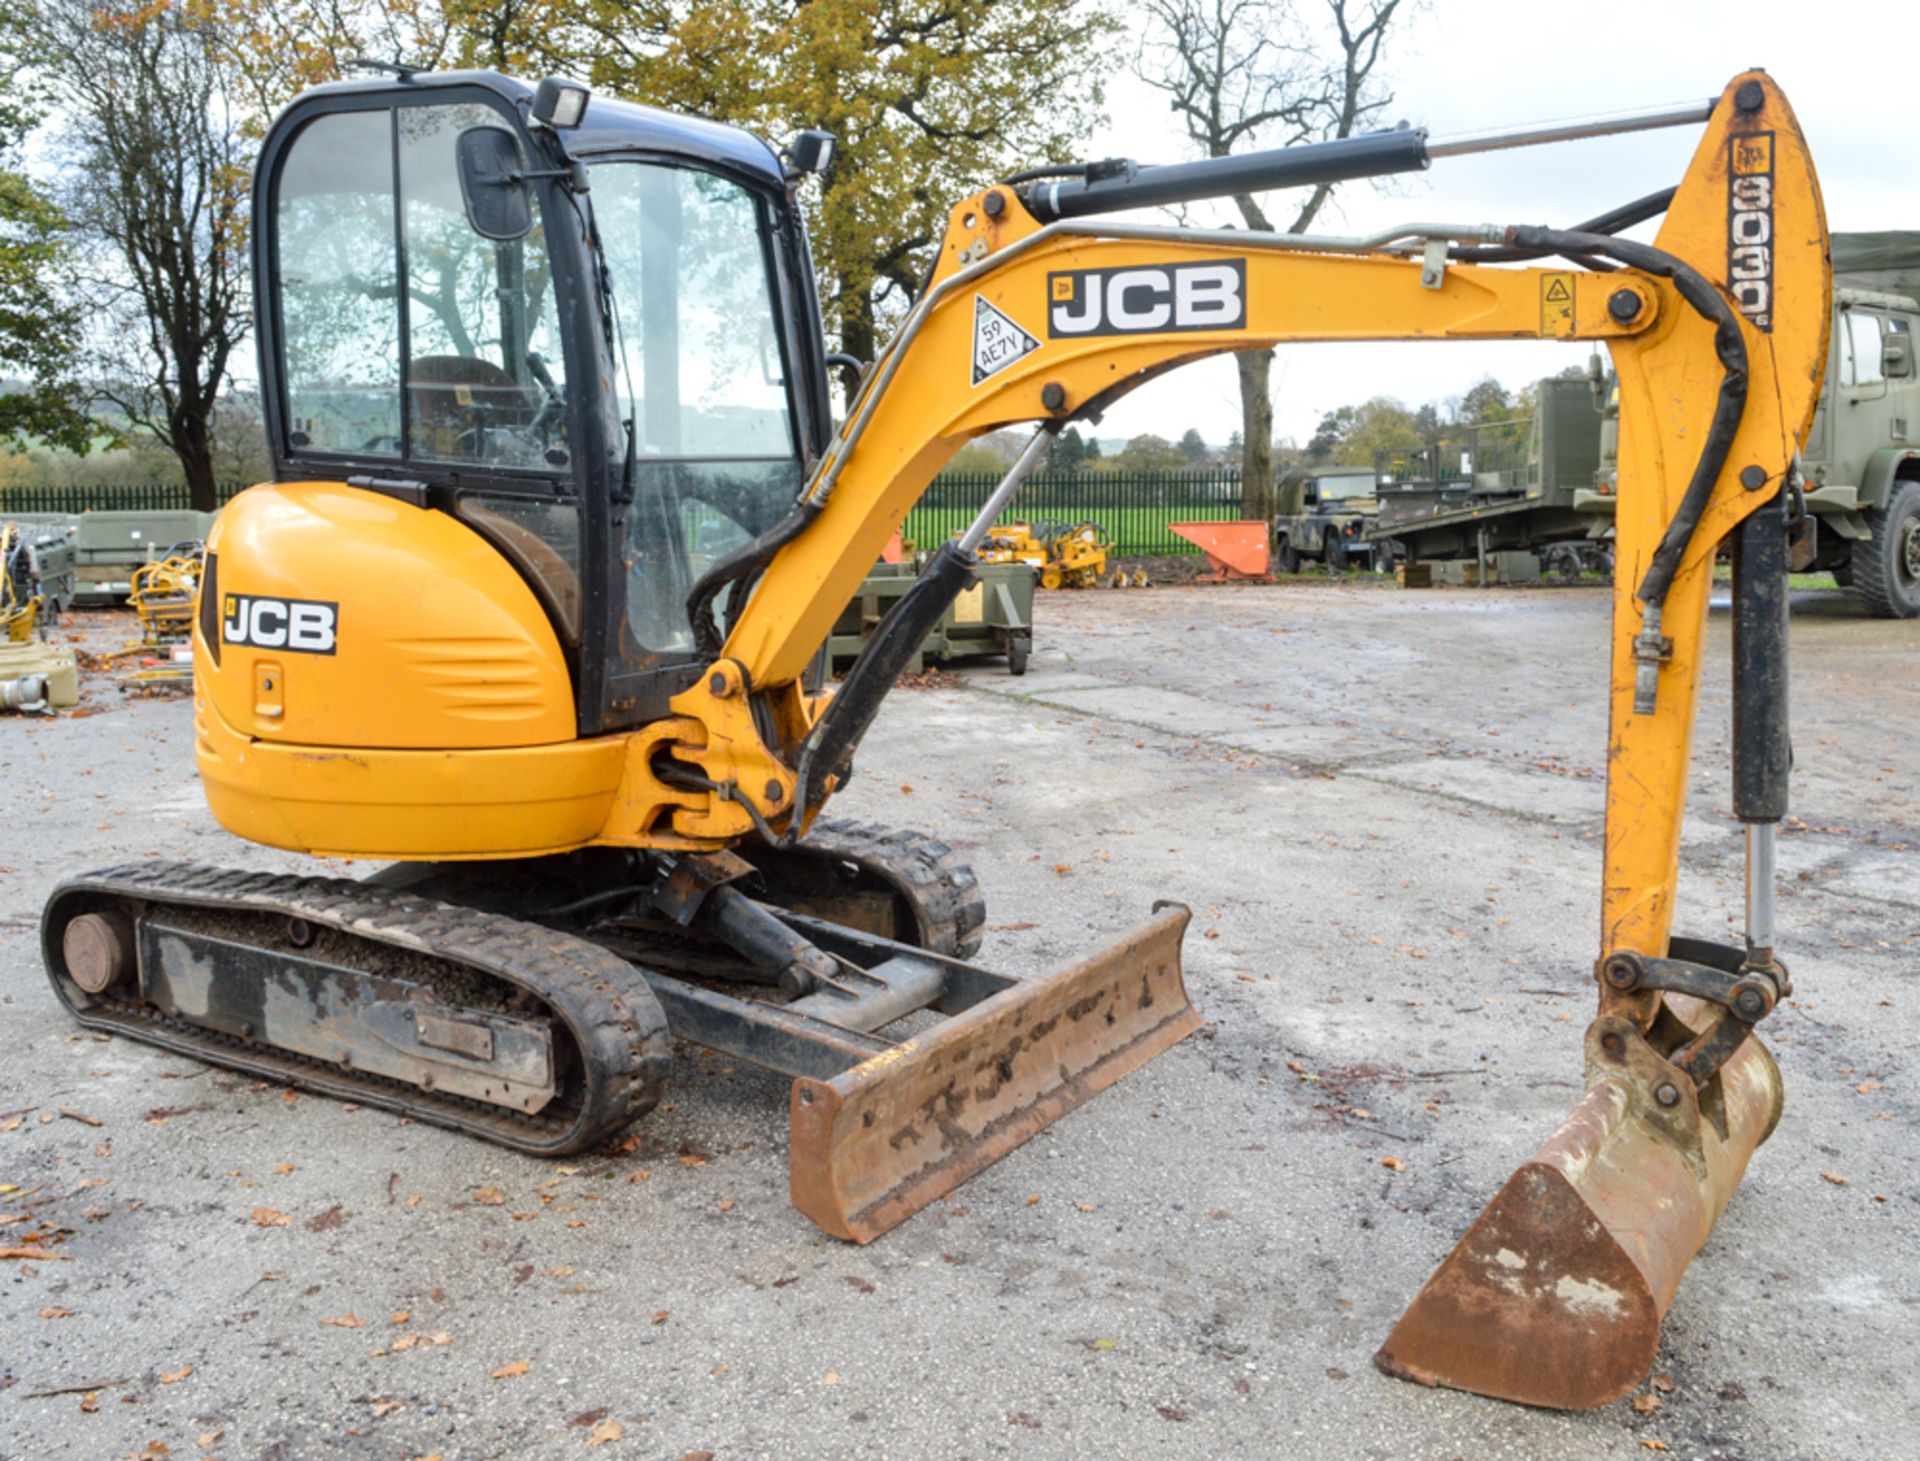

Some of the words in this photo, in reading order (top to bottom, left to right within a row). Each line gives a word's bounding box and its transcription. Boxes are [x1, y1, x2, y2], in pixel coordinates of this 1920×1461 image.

[1731, 176, 1771, 314] 8030
[1052, 265, 1243, 334] JCB
[980, 332, 1018, 367] AE7Y
[981, 320, 1002, 343] 59
[224, 598, 335, 651] JCB
